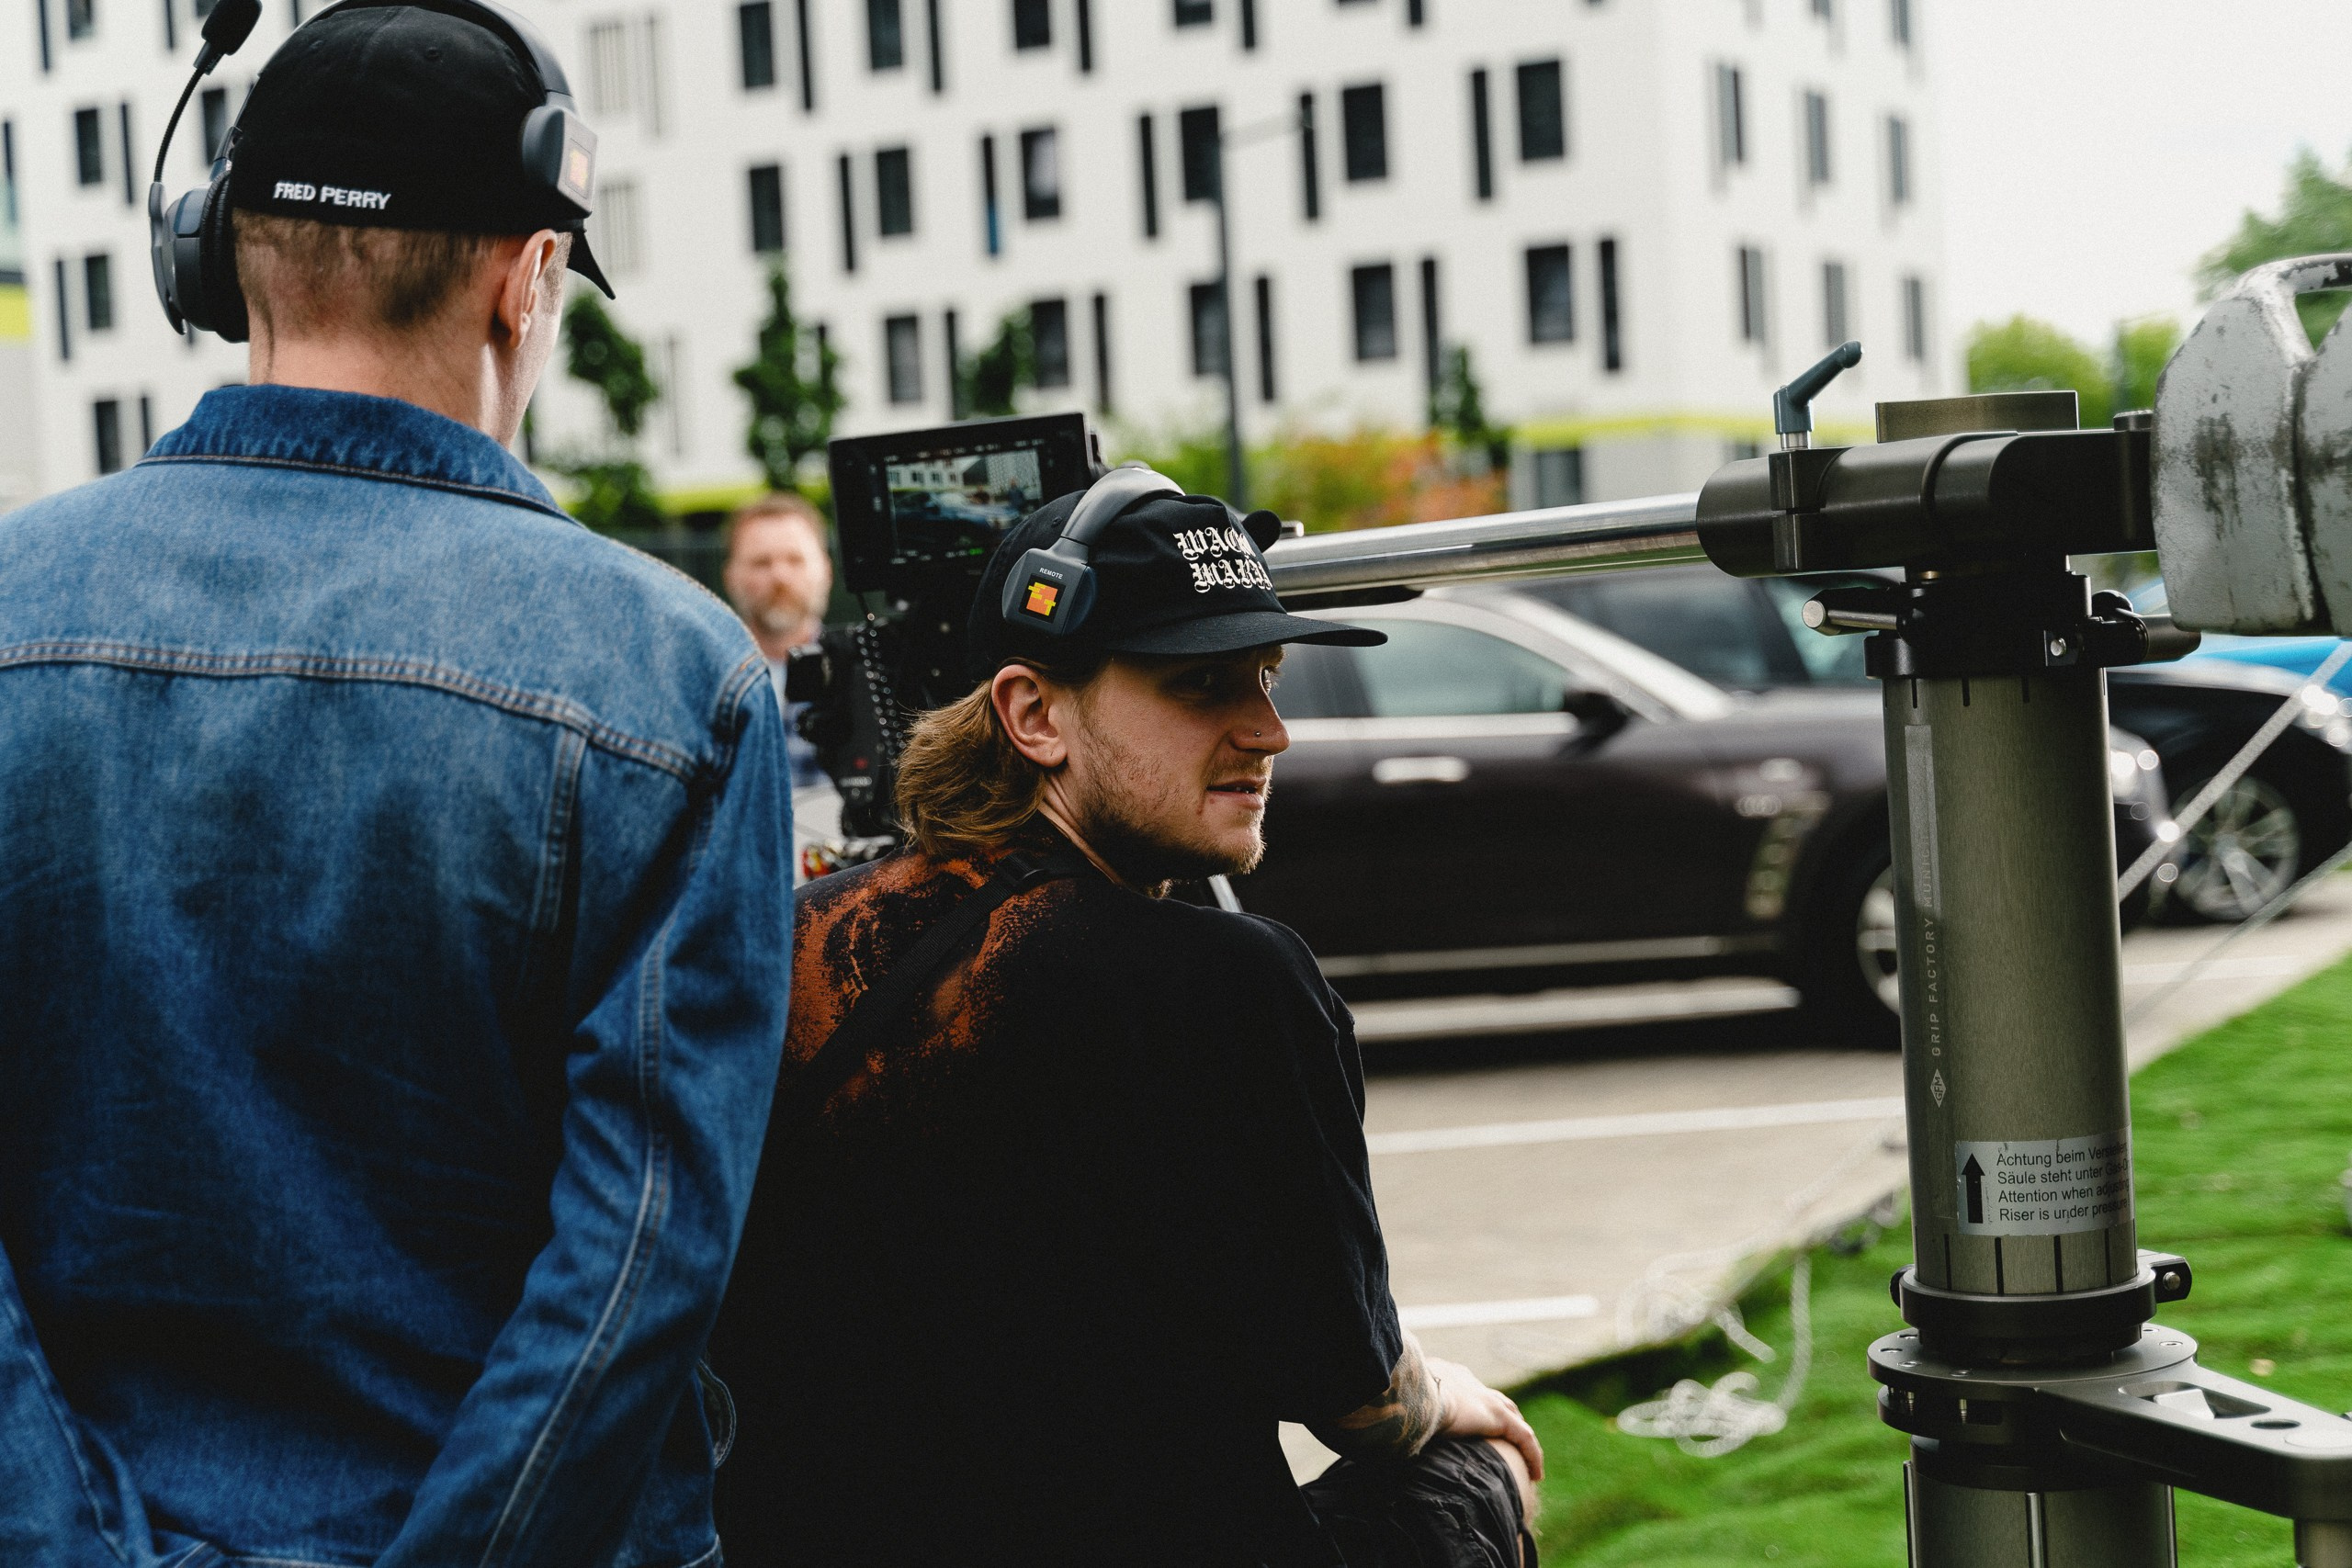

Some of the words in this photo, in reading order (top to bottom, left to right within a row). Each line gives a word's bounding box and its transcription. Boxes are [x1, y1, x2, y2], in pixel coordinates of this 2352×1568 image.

[273, 181, 316, 201] FRED
[320, 186, 391, 209] PERRY
[1039, 567, 1064, 580] REMOTE
[1924, 918, 1939, 1003] FACTORY
[1930, 1013, 1941, 1056] GRIP
[1996, 1152, 2052, 1168] Achtung
[2056, 1149, 2086, 1164] beim
[1997, 1170, 2036, 1185] Säule
[2041, 1169, 2073, 1183] steht
[2075, 1167, 2103, 1180] unter
[1998, 1190, 2058, 1203] Attention
[2061, 1187, 2093, 1200] when
[1999, 1208, 2035, 1222] Riser
[2039, 1208, 2050, 1221] is
[2053, 1205, 2089, 1220] under
